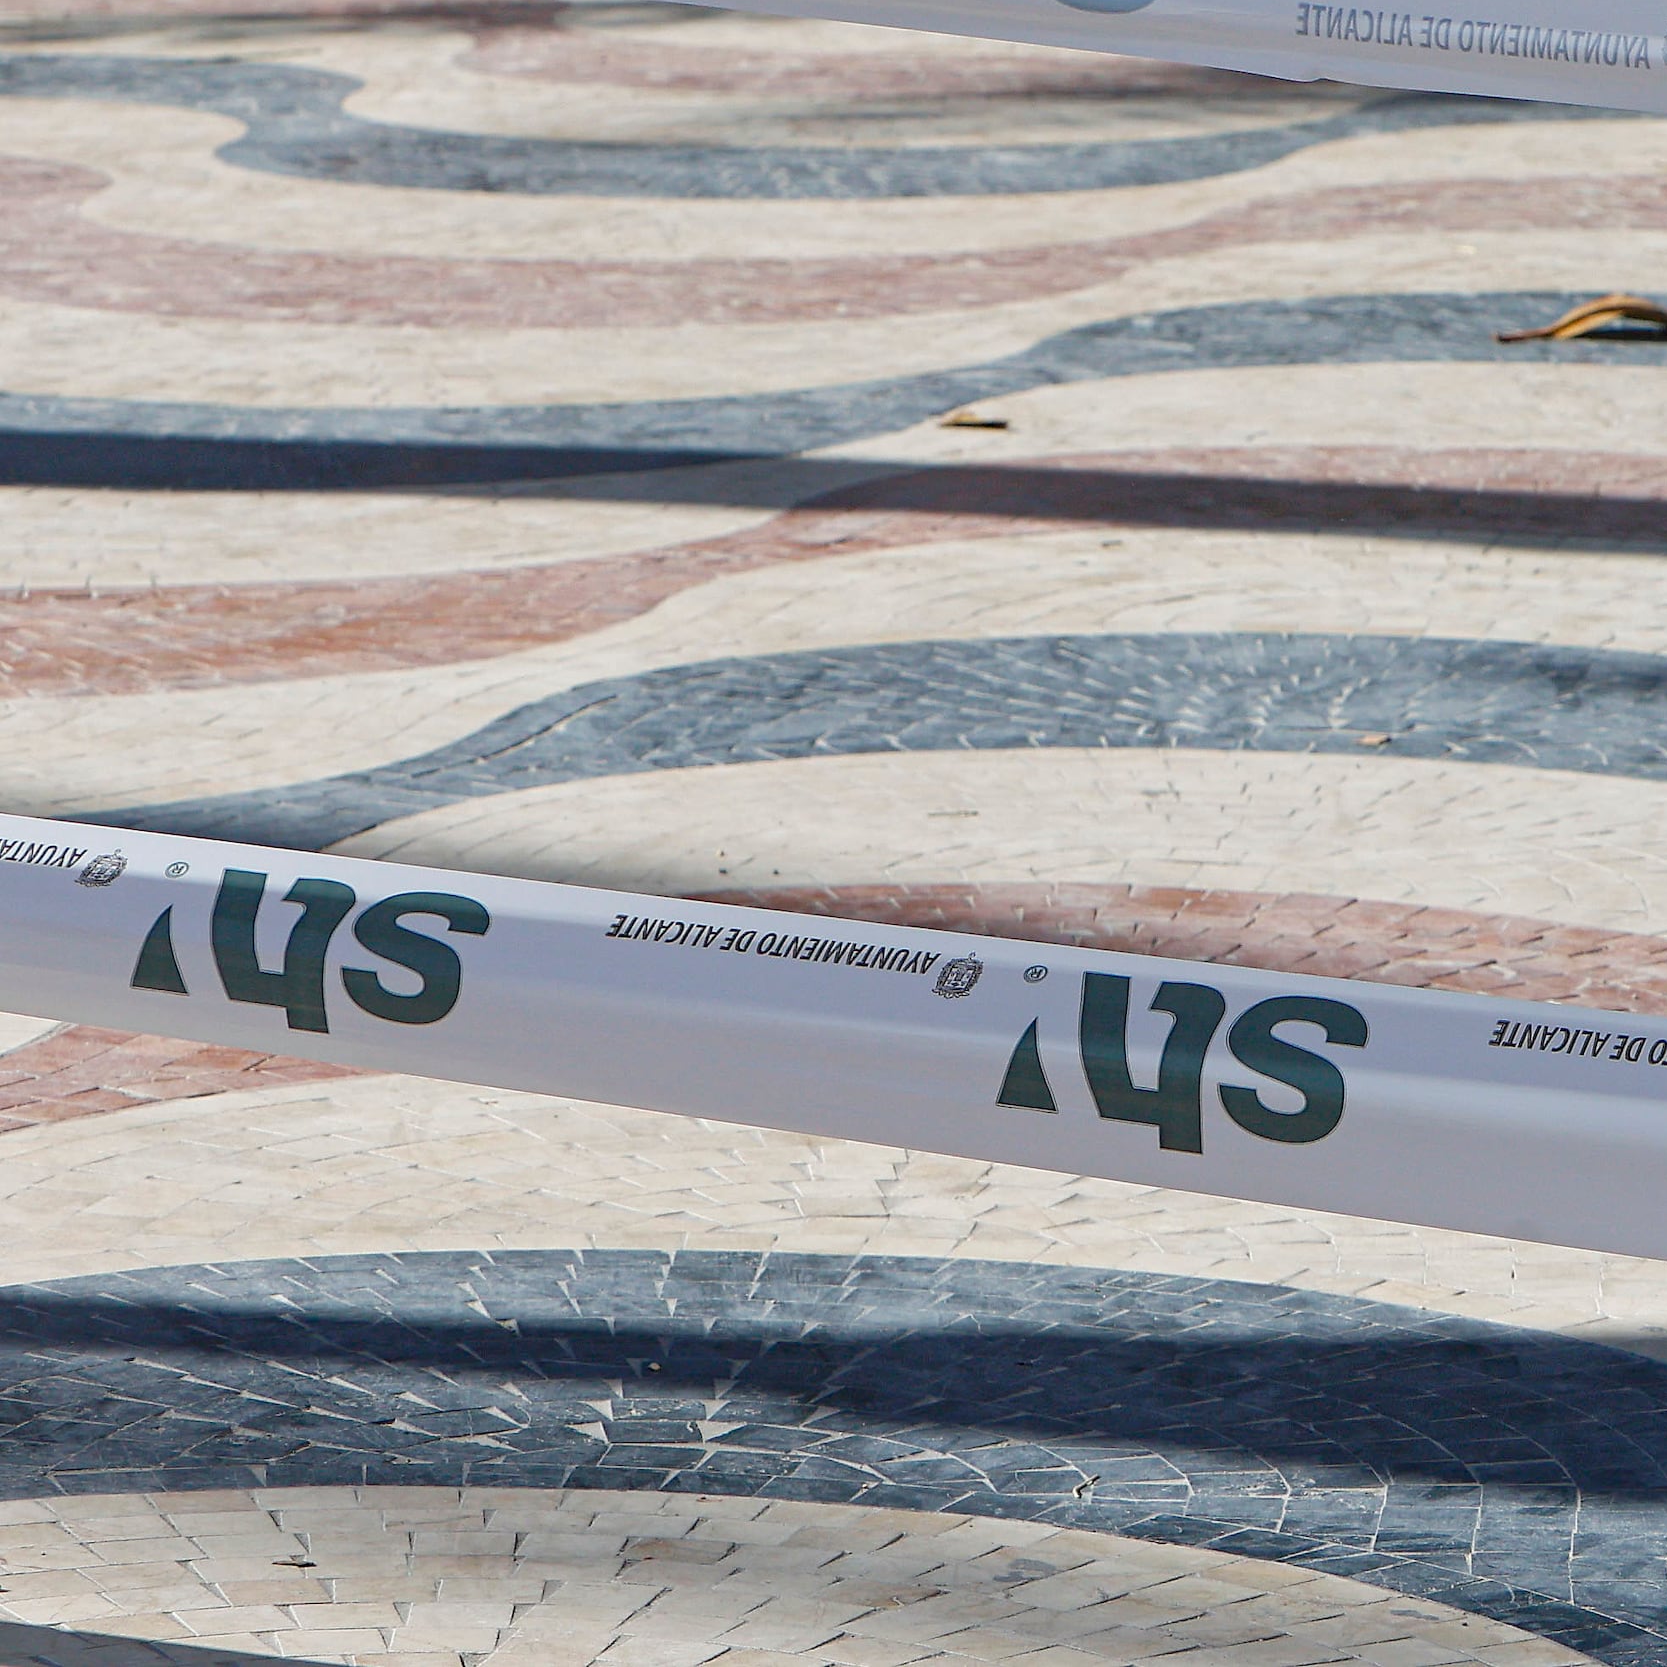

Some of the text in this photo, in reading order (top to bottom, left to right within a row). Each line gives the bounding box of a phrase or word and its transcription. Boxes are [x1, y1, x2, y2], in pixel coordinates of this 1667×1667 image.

[605, 914, 942, 975] AYUNTAMIENTO DE ALICANTE
[1488, 1019, 1612, 1057] ALICANTE
[1609, 1034, 1647, 1062] DE
